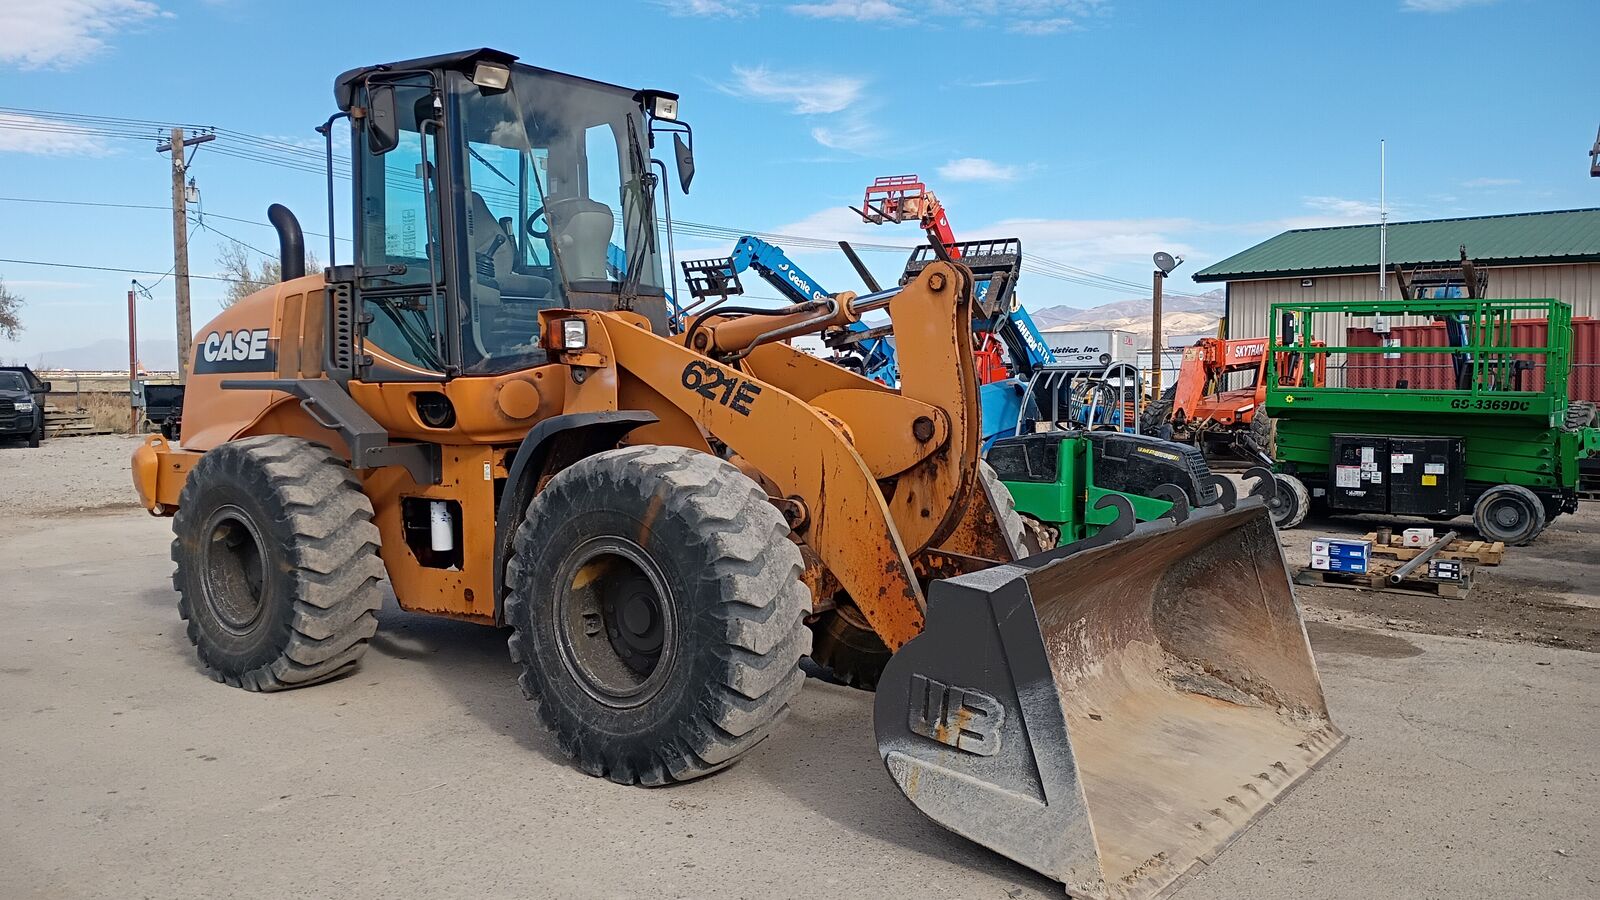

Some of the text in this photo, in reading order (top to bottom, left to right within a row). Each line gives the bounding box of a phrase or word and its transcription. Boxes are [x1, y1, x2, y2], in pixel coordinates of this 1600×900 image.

[788, 270, 811, 296] Genie
[203, 329, 269, 362] CASE
[1014, 319, 1038, 352] AHERN
[1083, 345, 1100, 353] Inc.
[1235, 343, 1265, 357] SKYTRAK
[682, 360, 762, 417] 621E
[1450, 398, 1530, 412] GS-3369DC
